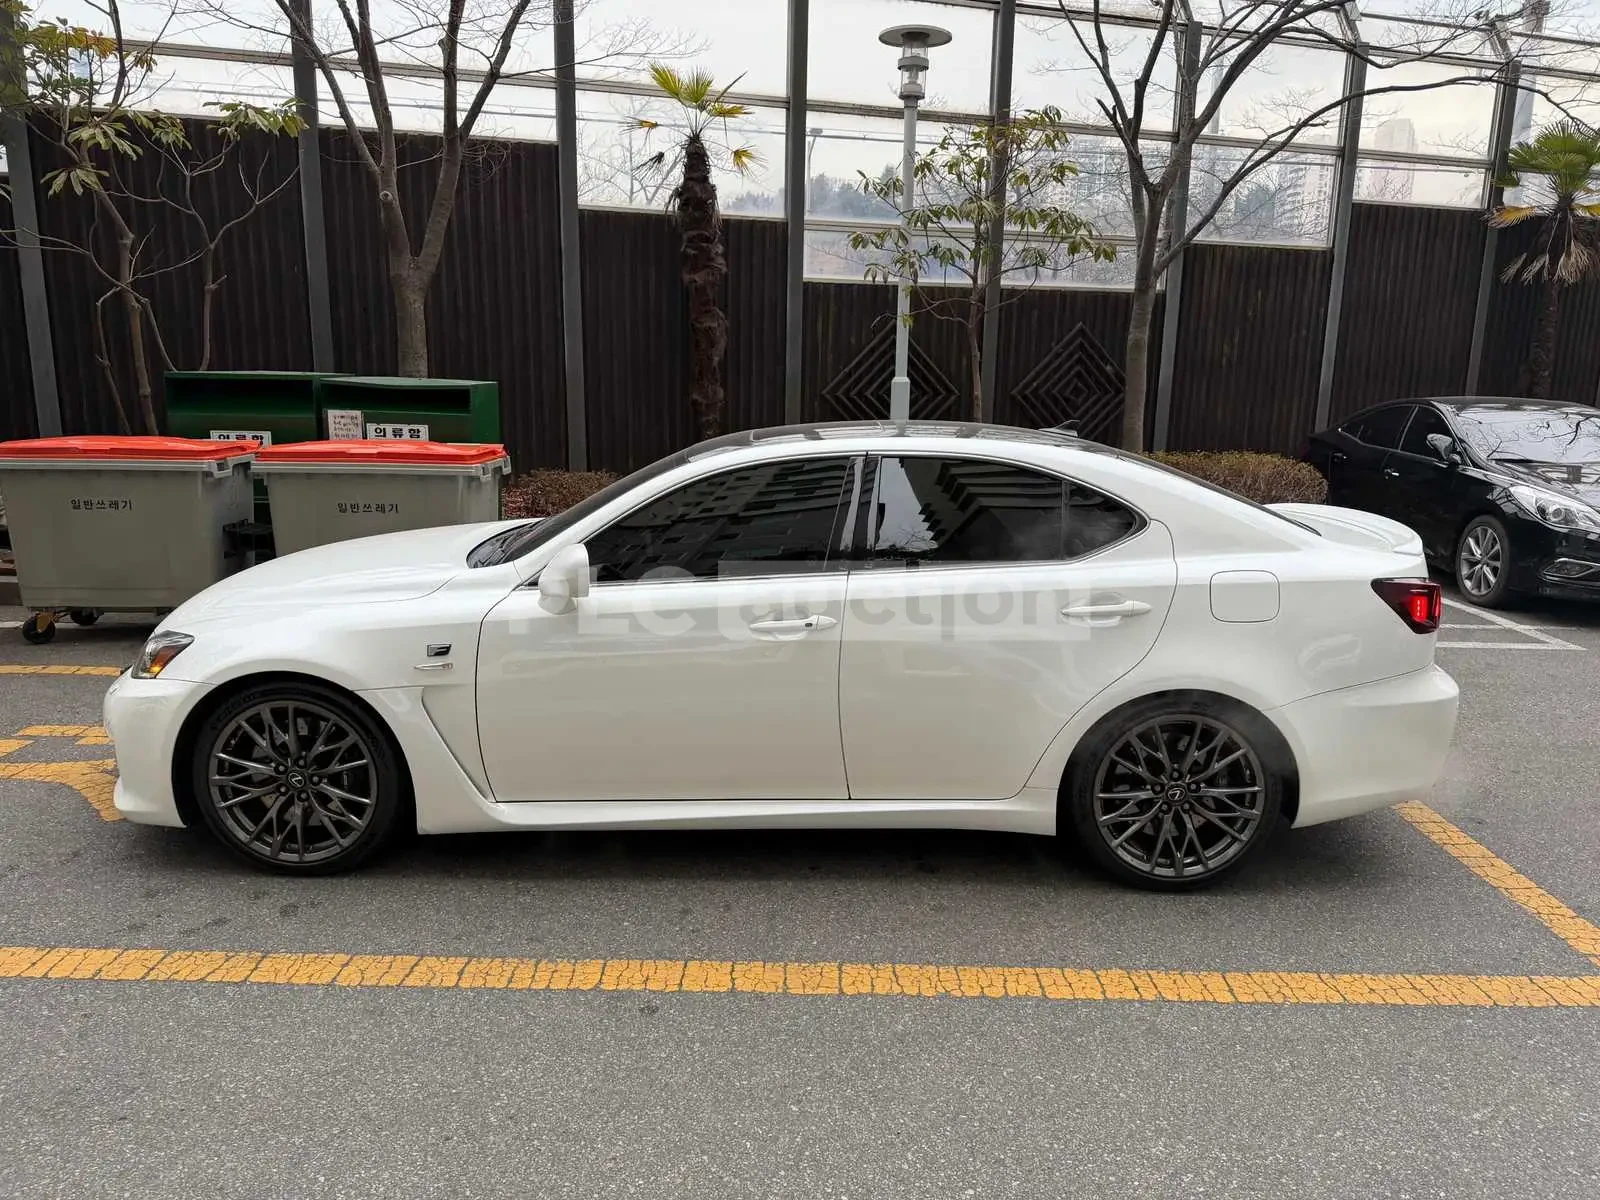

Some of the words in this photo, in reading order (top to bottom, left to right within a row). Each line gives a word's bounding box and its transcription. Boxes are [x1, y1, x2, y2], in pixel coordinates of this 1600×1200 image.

[374, 427, 421, 438] 의류함
[71, 499, 132, 510] 일반쓰레기
[338, 502, 398, 513] 일반쓰레기
